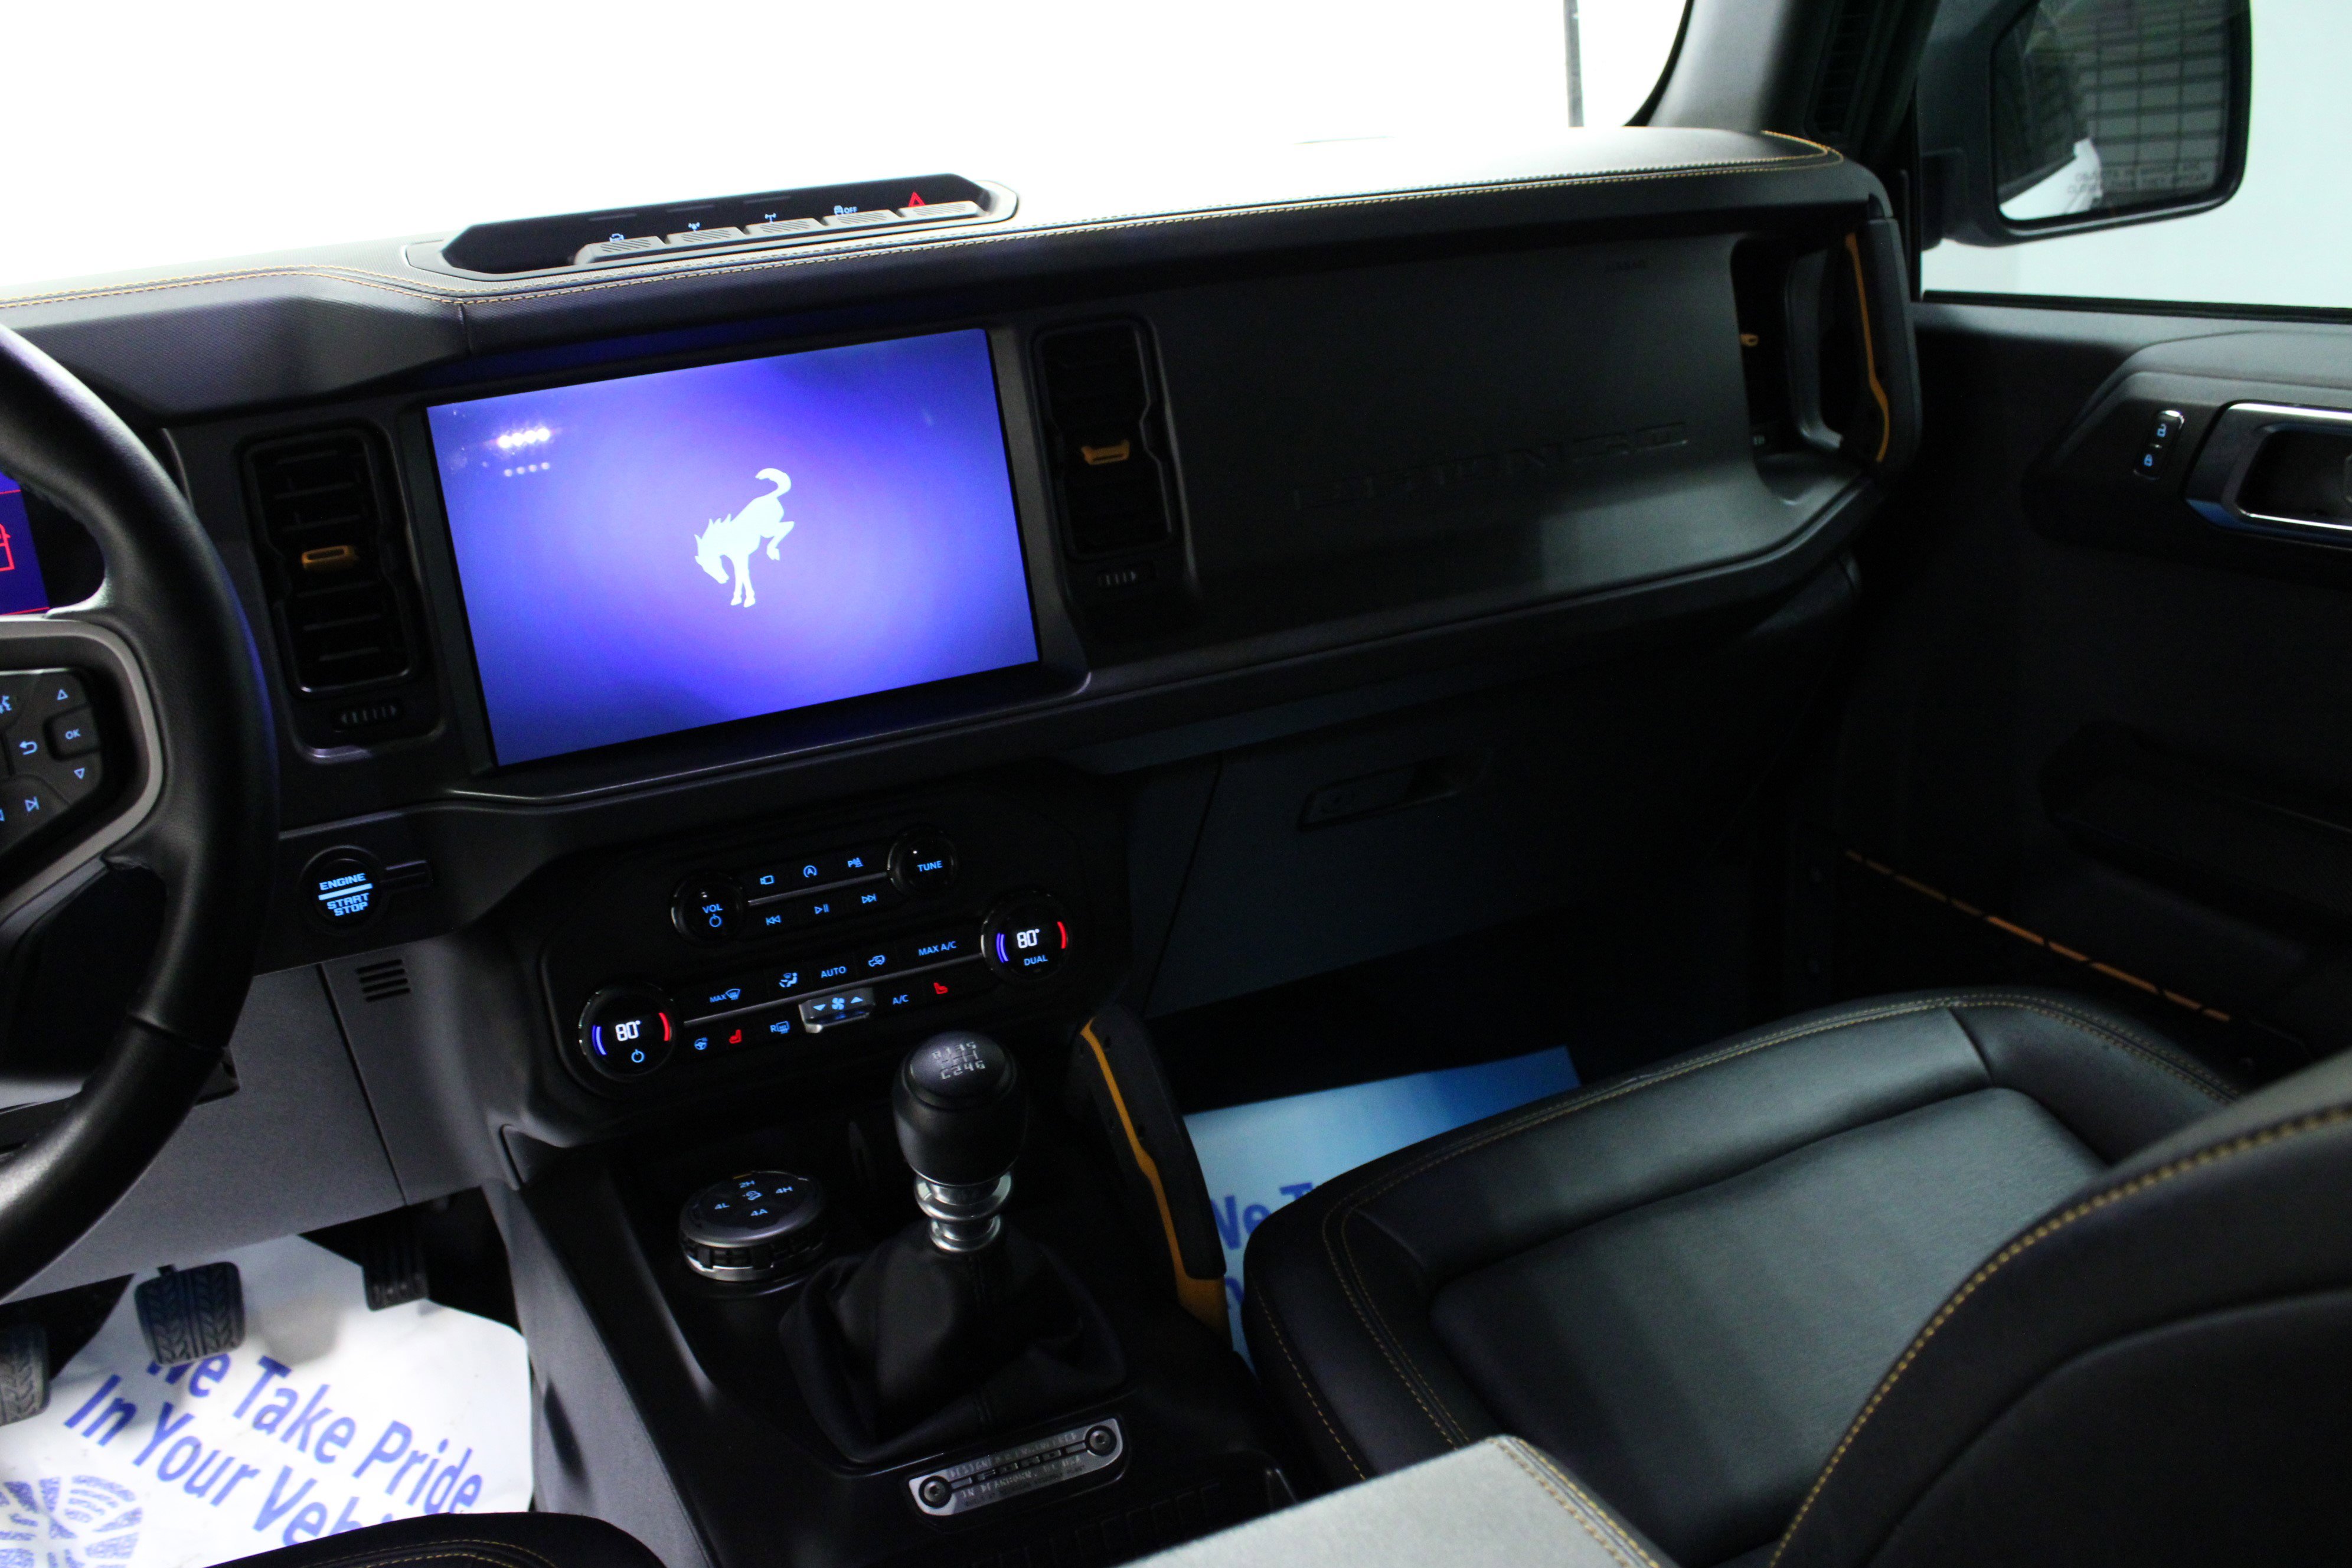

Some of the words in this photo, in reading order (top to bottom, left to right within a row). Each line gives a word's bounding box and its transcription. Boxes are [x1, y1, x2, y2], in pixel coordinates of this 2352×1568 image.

[66, 729, 81, 740] OK
[917, 860, 943, 872] TUNE
[319, 873, 367, 891] ENGINE
[326, 892, 370, 910] START
[334, 901, 369, 917] STOP
[702, 903, 723, 914] VOL
[919, 945, 940, 956] MAX
[940, 940, 957, 952] A/C
[1024, 955, 1048, 966] DUAL
[821, 966, 847, 978] AUTO
[710, 993, 726, 1003] MAX
[893, 994, 909, 1005] A/C
[951, 1064, 963, 1076] 2
[963, 1062, 974, 1071] 4
[975, 1060, 985, 1069] 6
[740, 1180, 756, 1188] 2H
[146, 1353, 230, 1397] e
[232, 1355, 357, 1464] Take
[353, 1420, 482, 1515] Pride
[63, 1374, 137, 1447] In
[132, 1401, 261, 1507] Your
